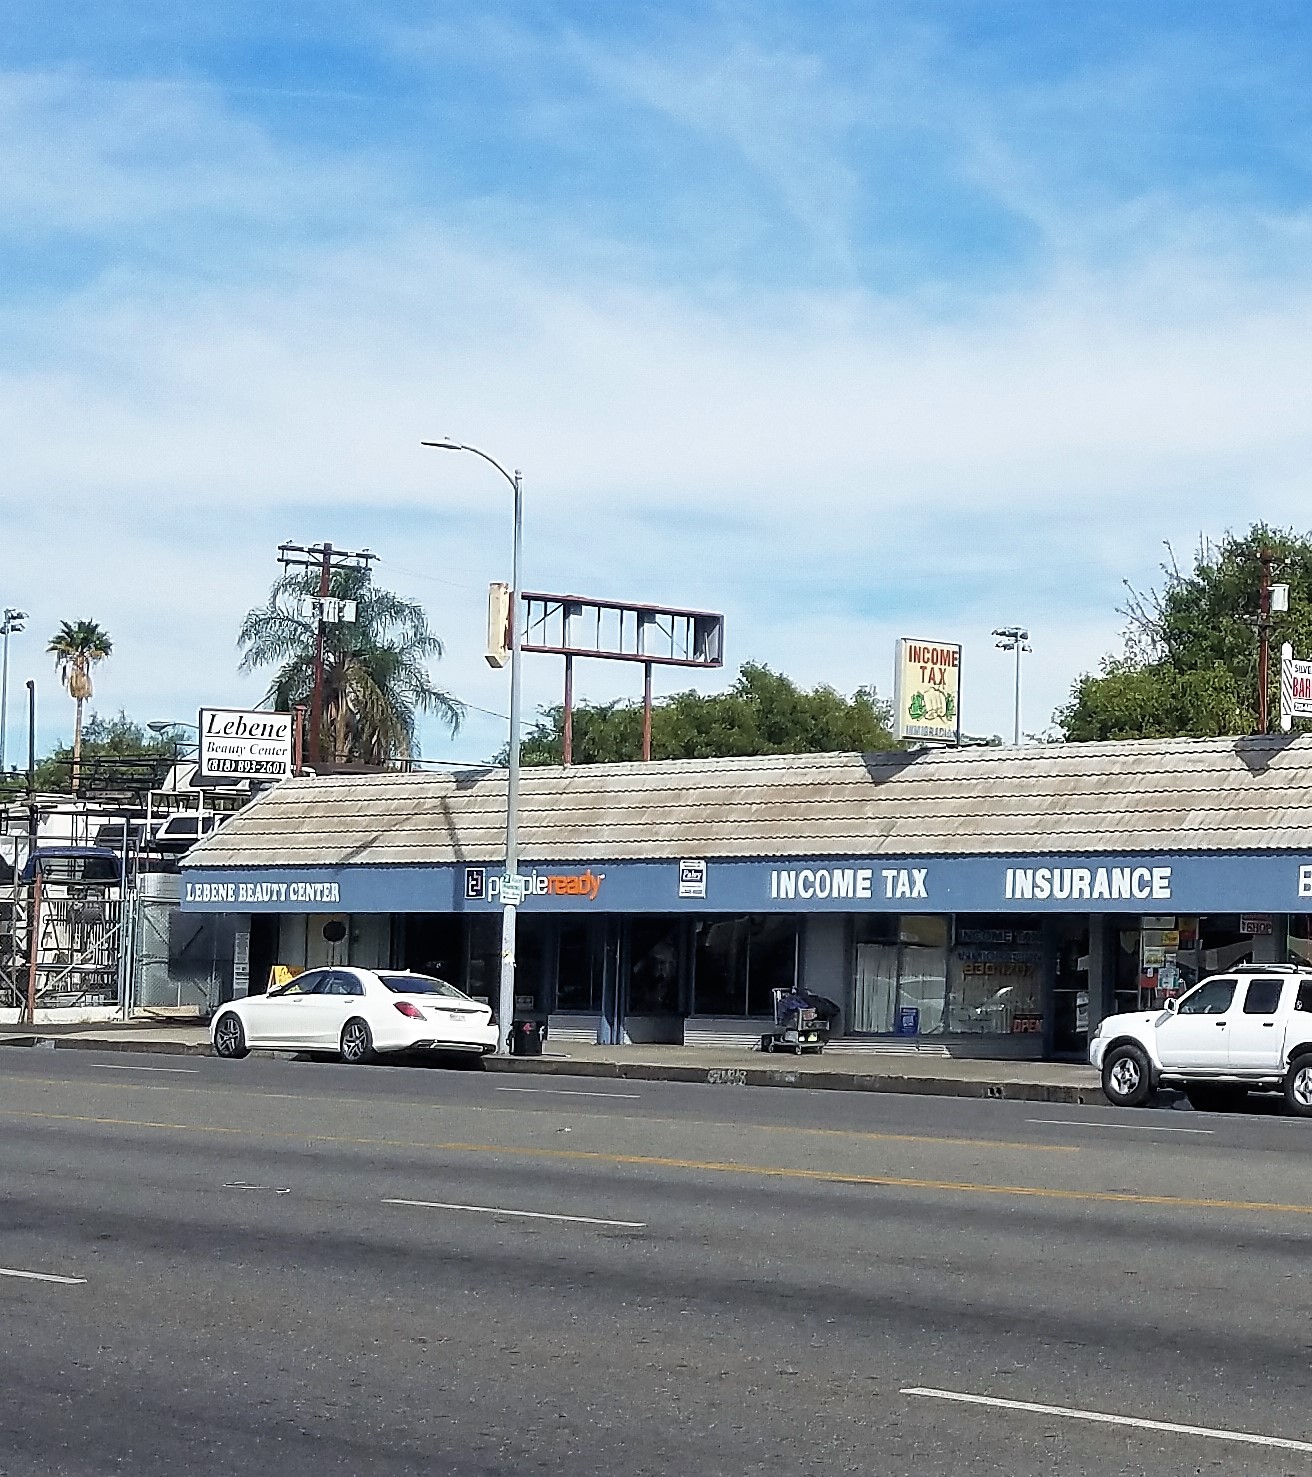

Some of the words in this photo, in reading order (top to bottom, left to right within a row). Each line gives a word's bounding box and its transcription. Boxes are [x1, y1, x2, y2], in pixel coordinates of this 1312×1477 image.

[908, 644, 959, 668] INCOME
[919, 665, 947, 686] TAX
[206, 713, 288, 738] Lebene
[207, 742, 246, 757] Beauty
[249, 743, 288, 756] Center
[208, 759, 236, 772] (818)
[237, 760, 285, 774] 893-2601
[185, 882, 237, 902] LEBENE
[238, 882, 288, 902] BEAUTY
[289, 882, 340, 902] CENTER
[487, 868, 602, 902] ppleready
[770, 868, 872, 899] INCOME
[881, 869, 928, 899] TAX
[1005, 867, 1172, 899] INSURANCE
